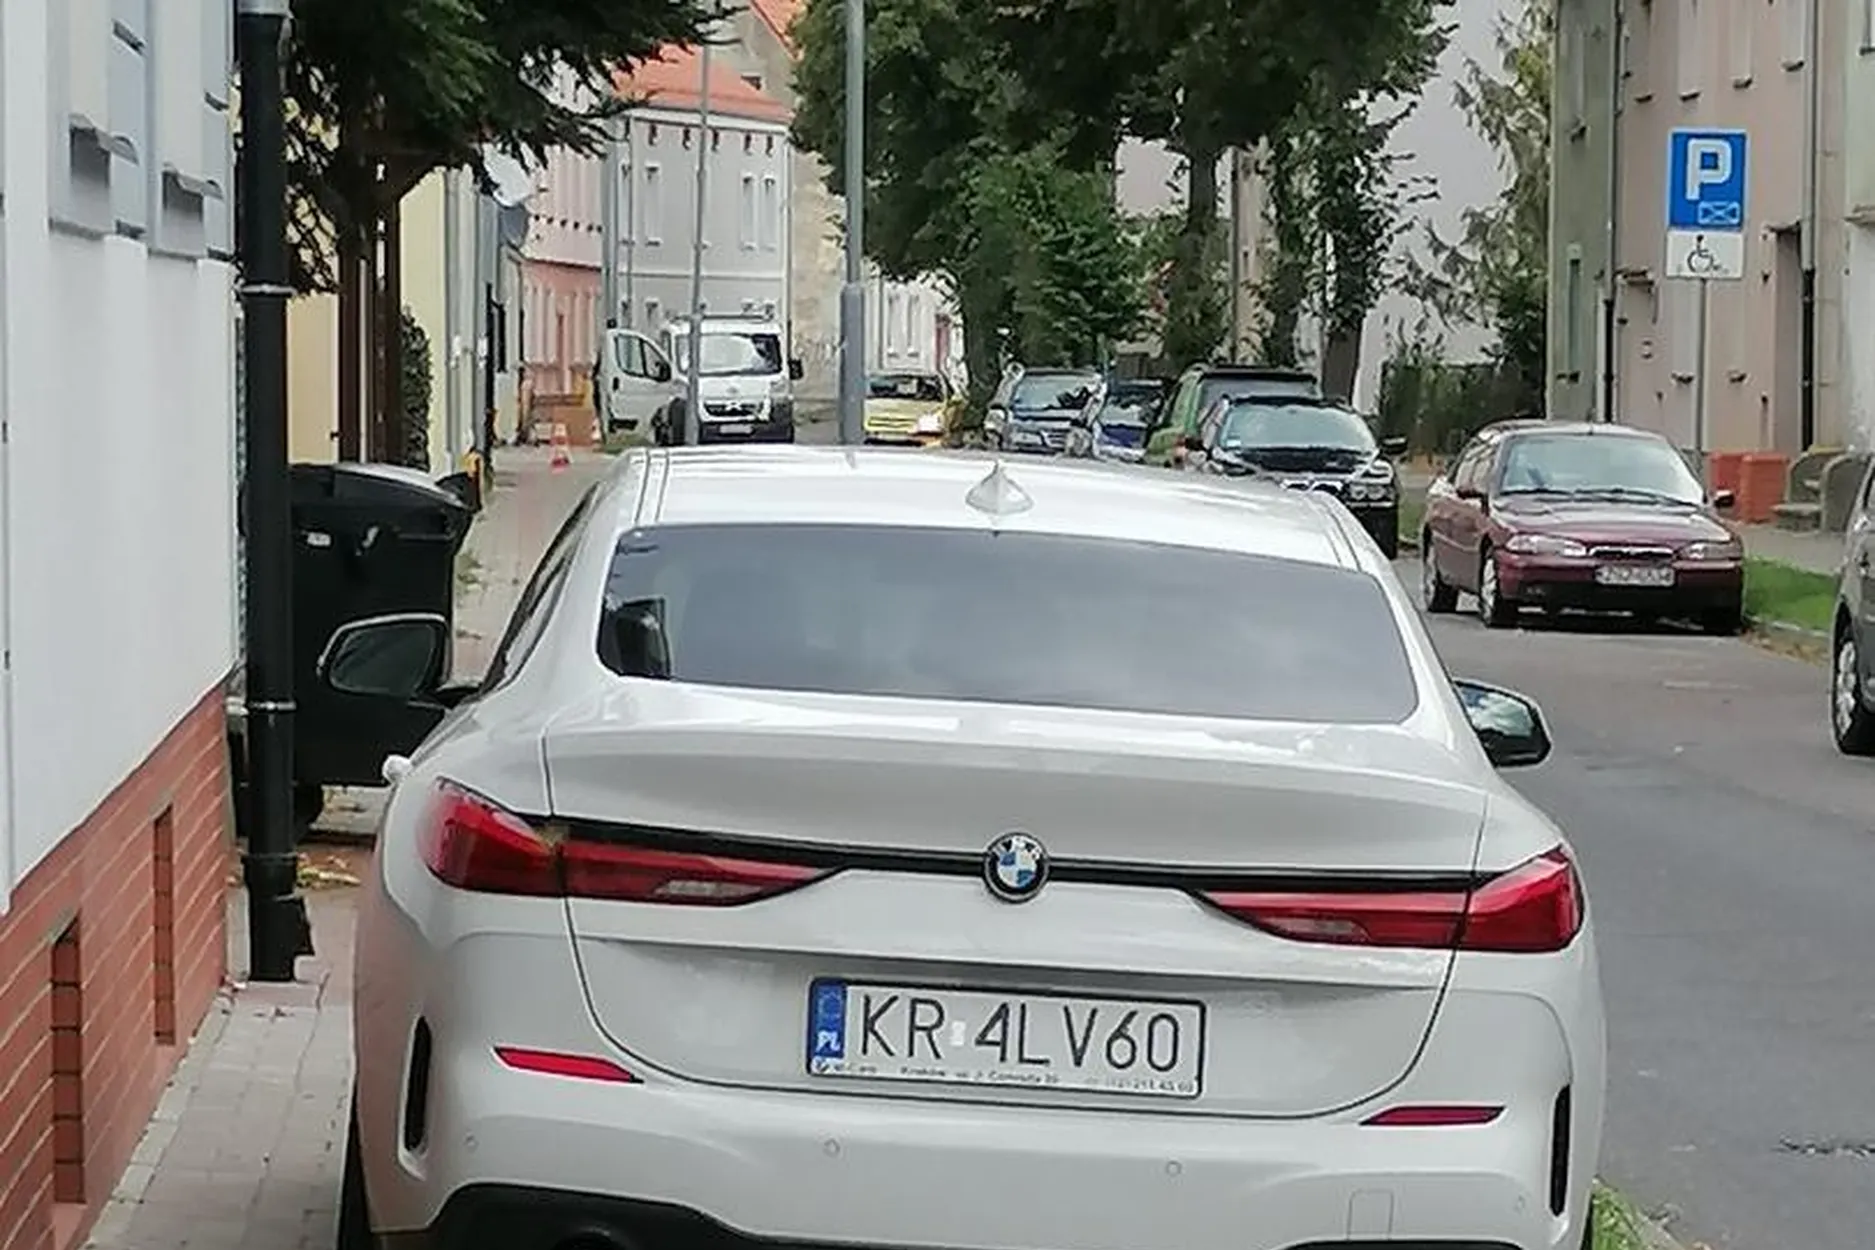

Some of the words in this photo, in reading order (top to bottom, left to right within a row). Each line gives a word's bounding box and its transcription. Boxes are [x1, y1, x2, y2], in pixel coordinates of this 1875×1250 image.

[1686, 138, 1732, 200] P
[860, 994, 945, 1059] KR
[974, 1001, 1180, 1073] 4LV60
